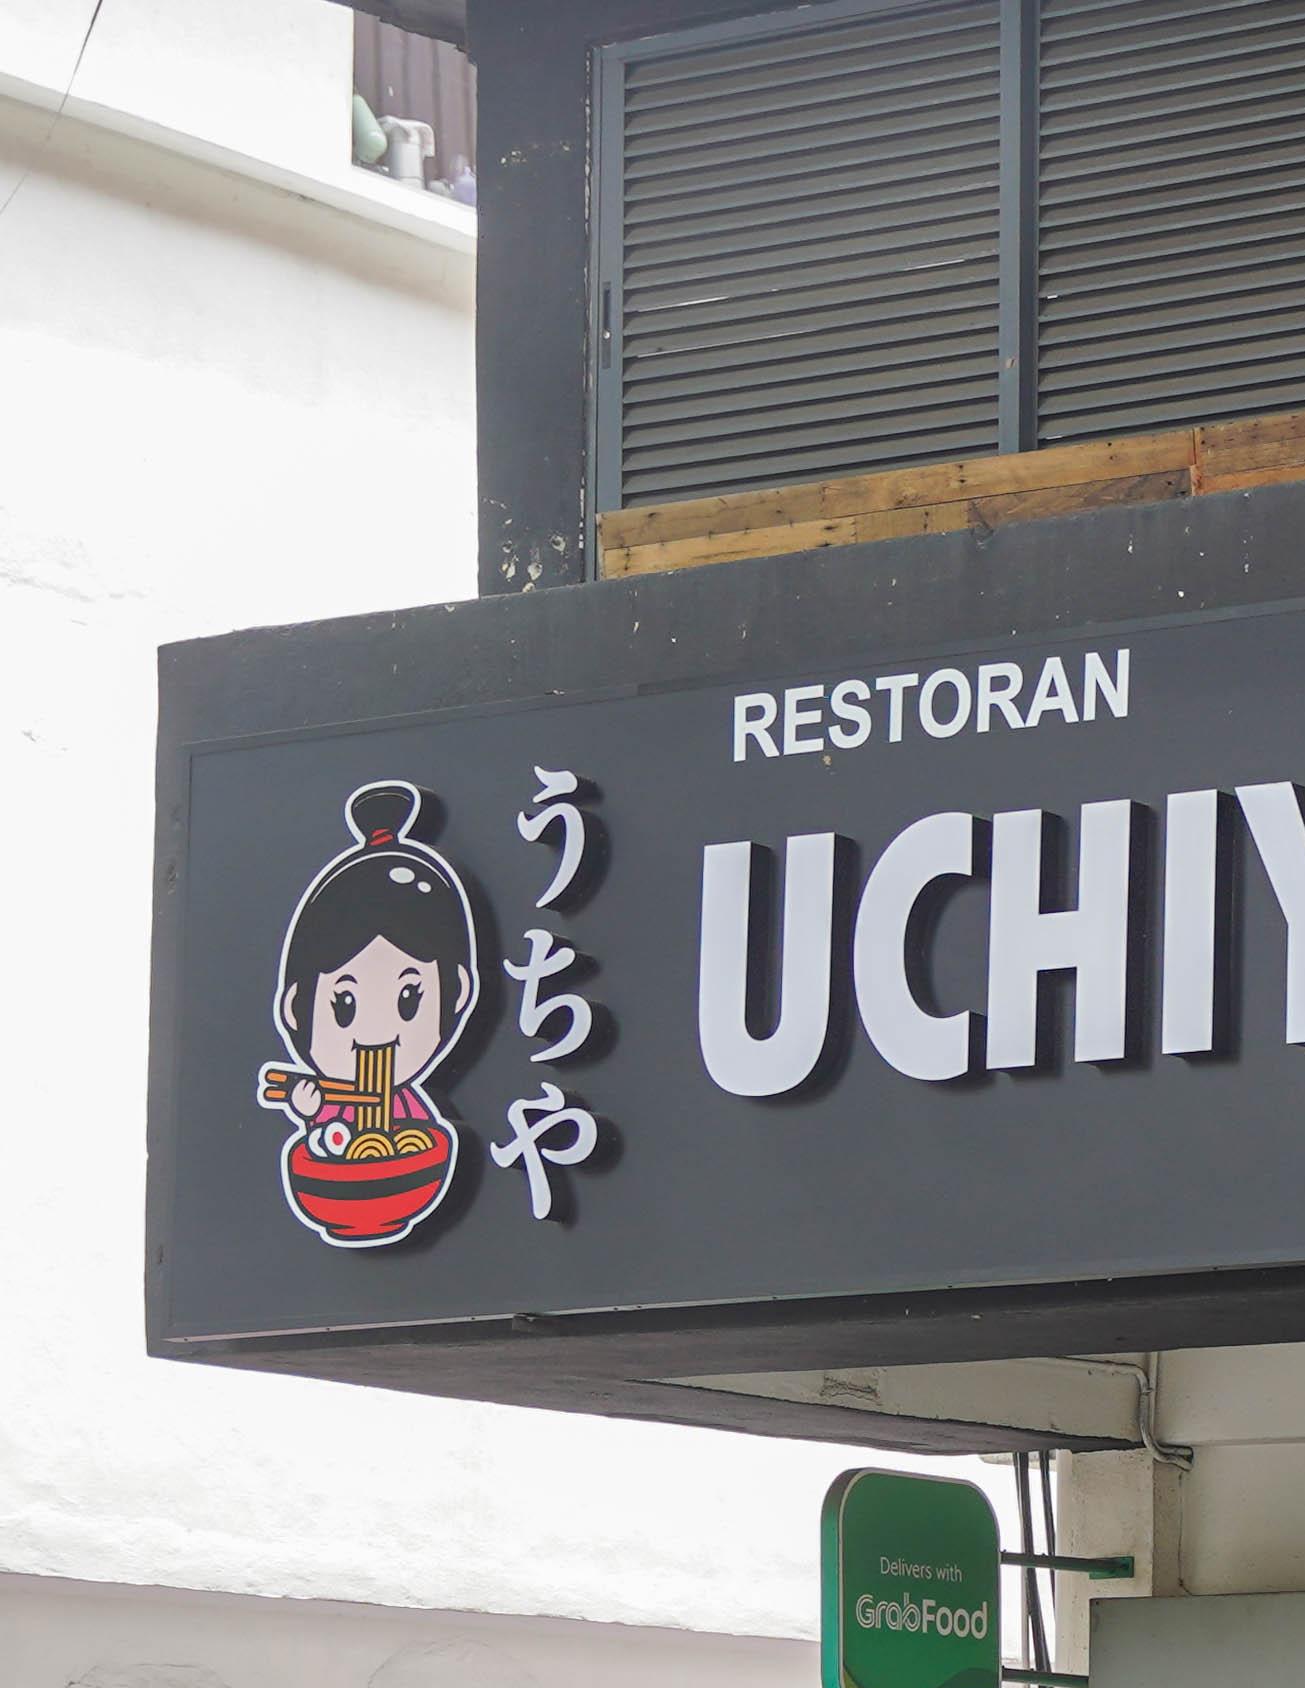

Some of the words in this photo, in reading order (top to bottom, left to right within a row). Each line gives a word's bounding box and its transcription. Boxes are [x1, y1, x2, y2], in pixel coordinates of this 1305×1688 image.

[732, 648, 1132, 762] RESTORAN
[489, 765, 598, 1221] うちや
[880, 1556, 933, 1580] Delivers
[936, 1563, 963, 1583] with
[855, 1592, 988, 1640] GrabFood
